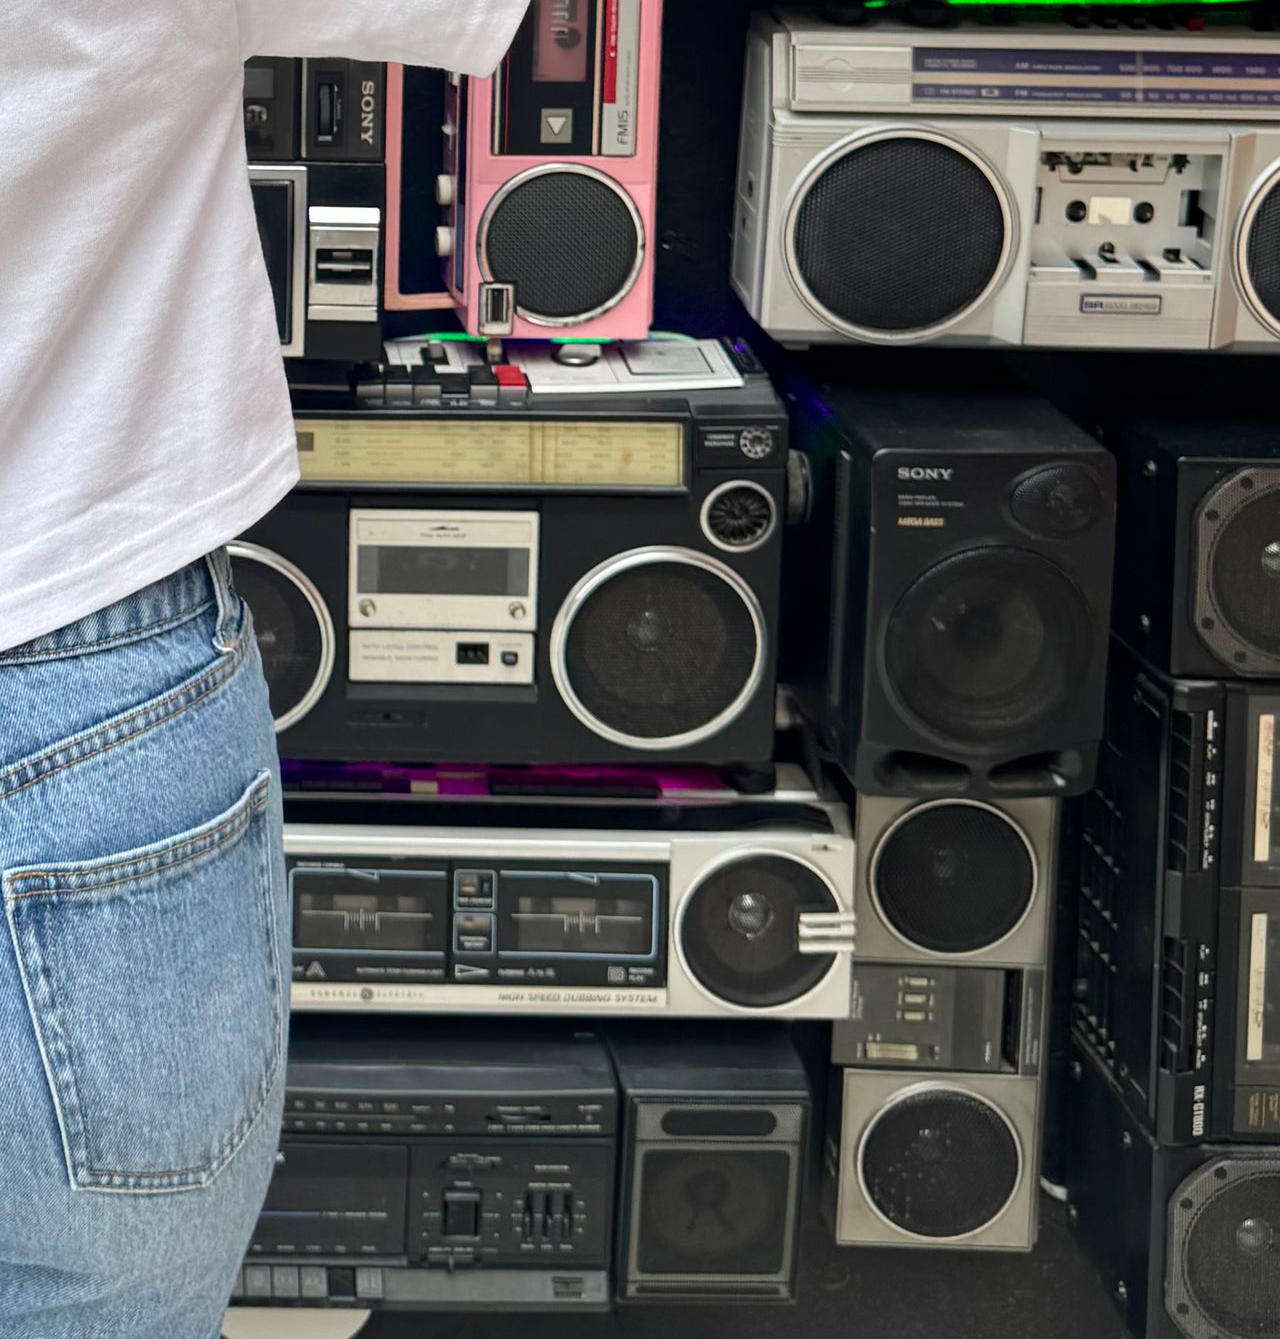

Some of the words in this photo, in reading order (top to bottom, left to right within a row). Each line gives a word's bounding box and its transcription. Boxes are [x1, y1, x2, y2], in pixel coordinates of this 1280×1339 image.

[360, 80, 375, 147] SONY
[897, 466, 954, 480] SONY
[498, 992, 525, 1002] HIGH
[528, 992, 560, 1002] SPEED
[563, 993, 610, 1003] DUBBING
[614, 994, 658, 1004] SYSTEM
